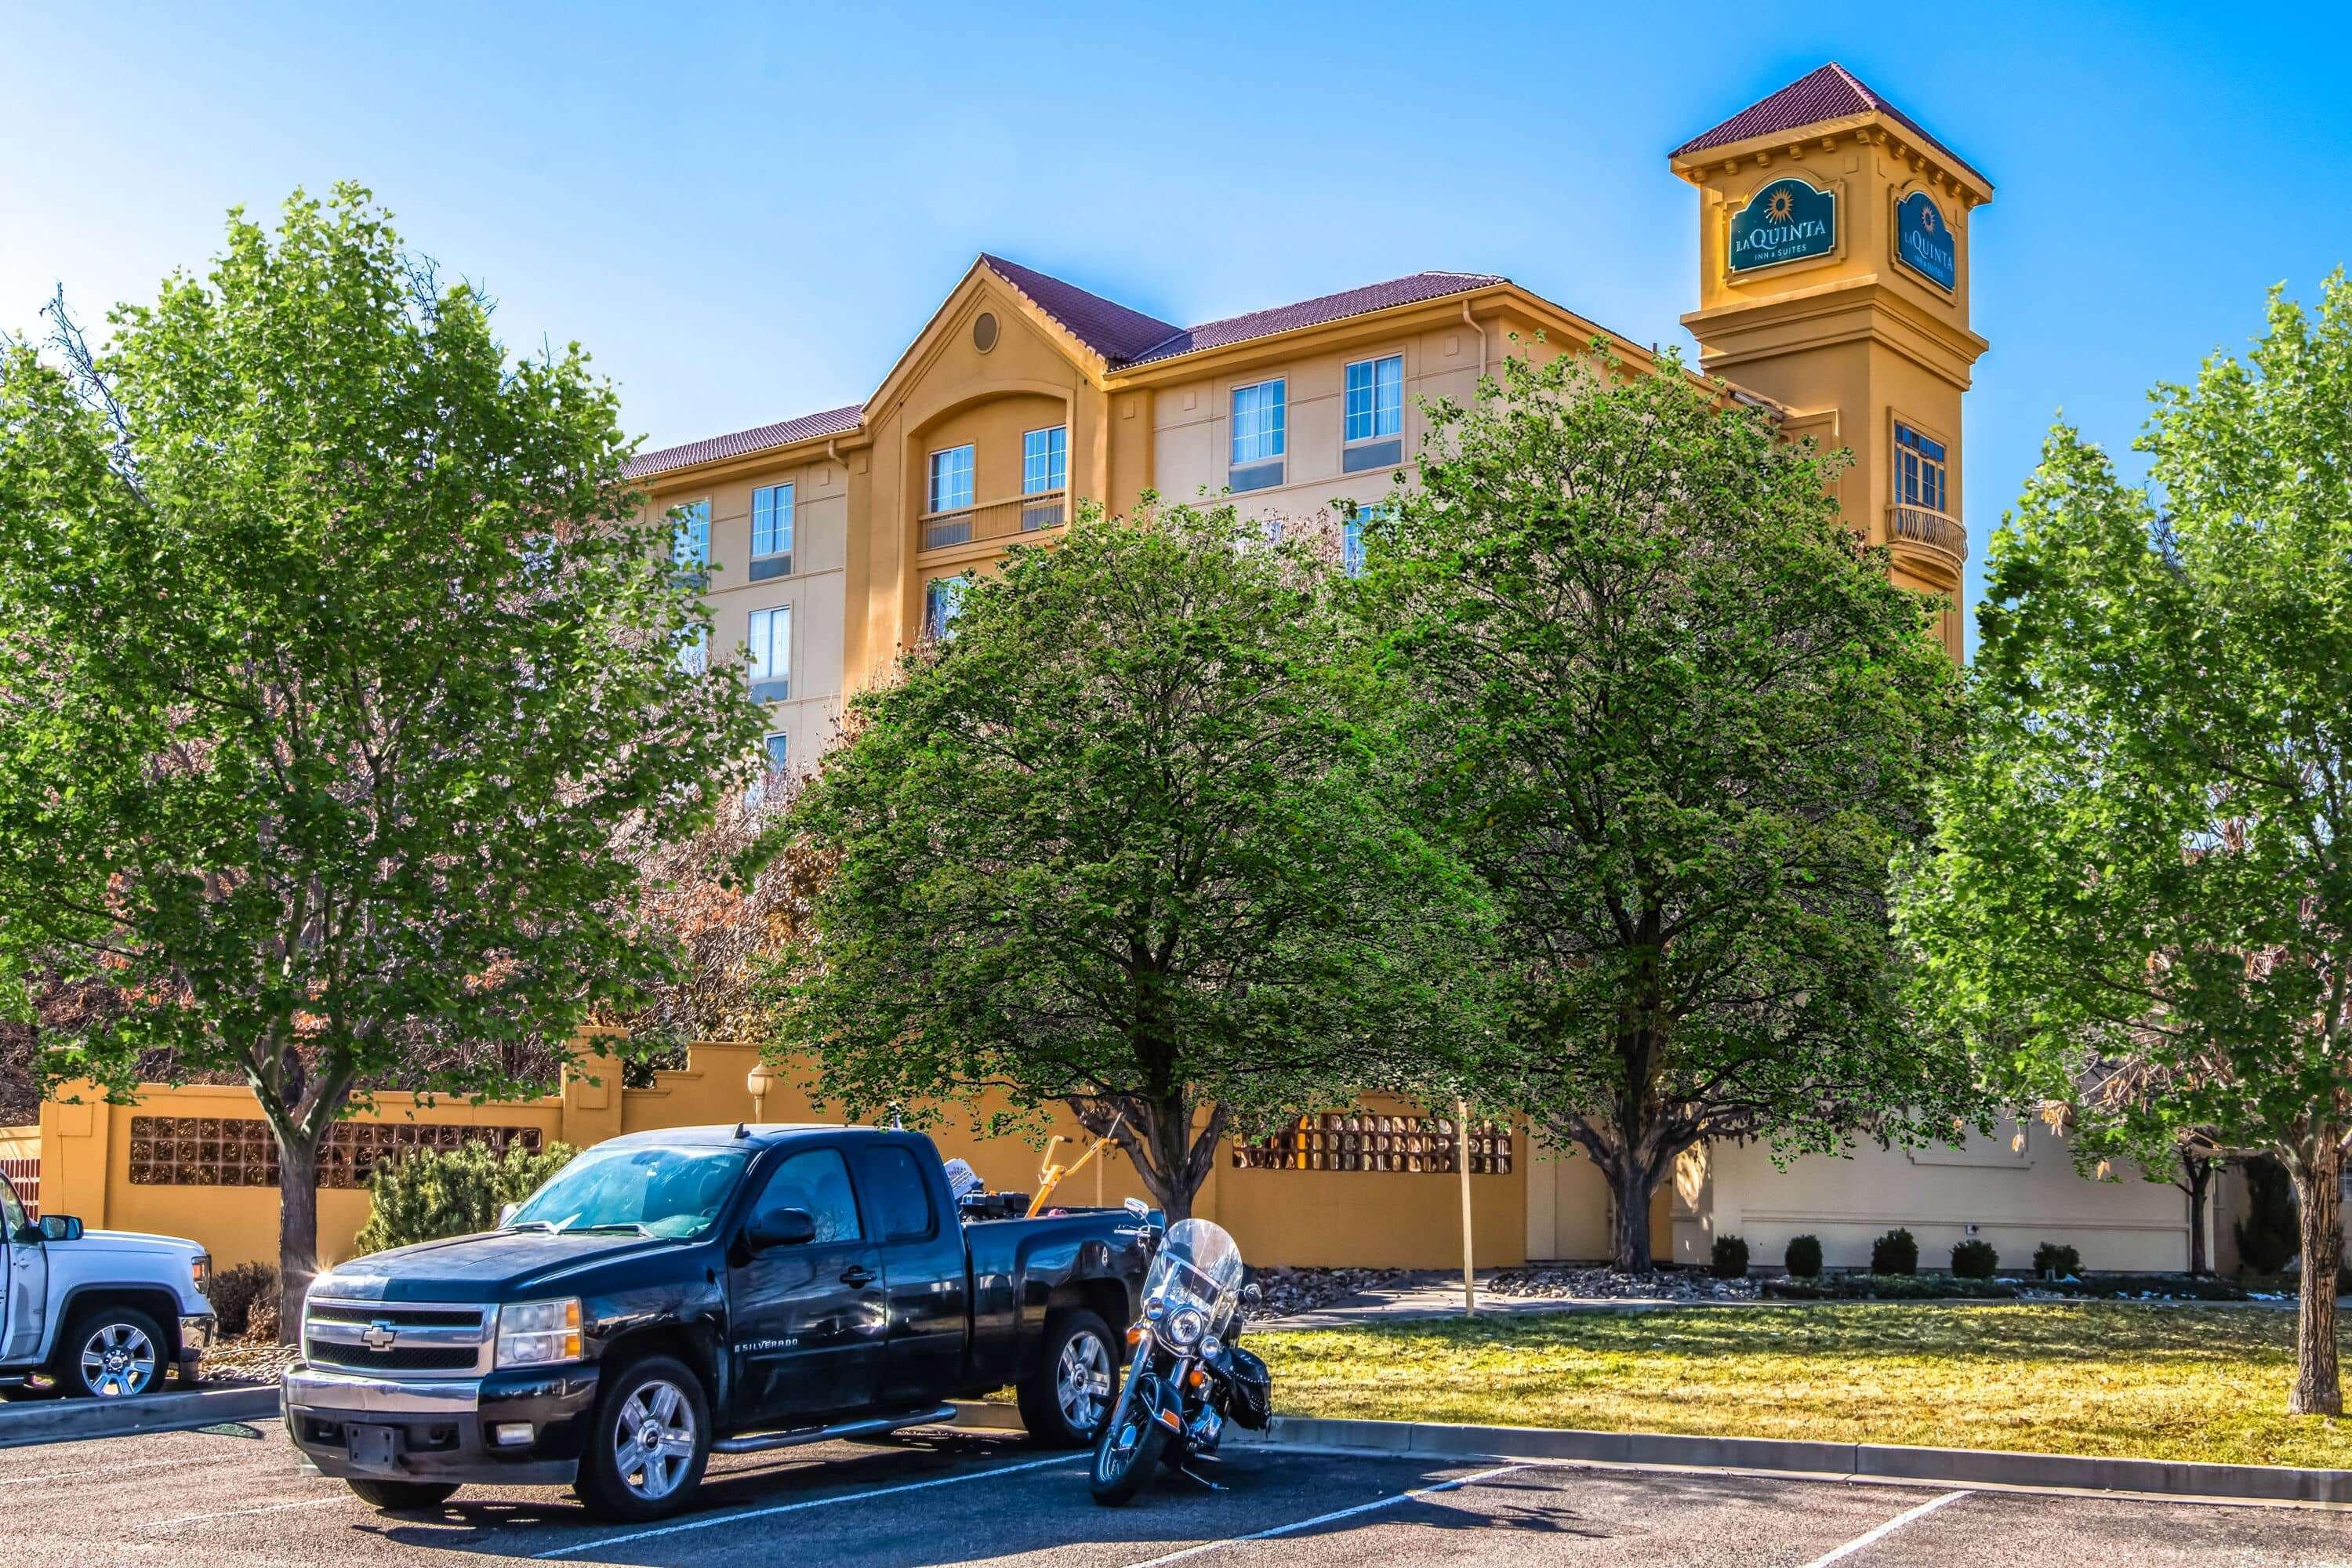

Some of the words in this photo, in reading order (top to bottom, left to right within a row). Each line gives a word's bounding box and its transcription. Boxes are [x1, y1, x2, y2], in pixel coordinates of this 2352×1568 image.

[1750, 219, 1826, 250] QUINTA
[1755, 252, 1769, 260] INN
[1777, 244, 1807, 256] SUITES
[1913, 230, 1953, 272] QUINTA
[742, 1338, 797, 1351] SILVERADO
